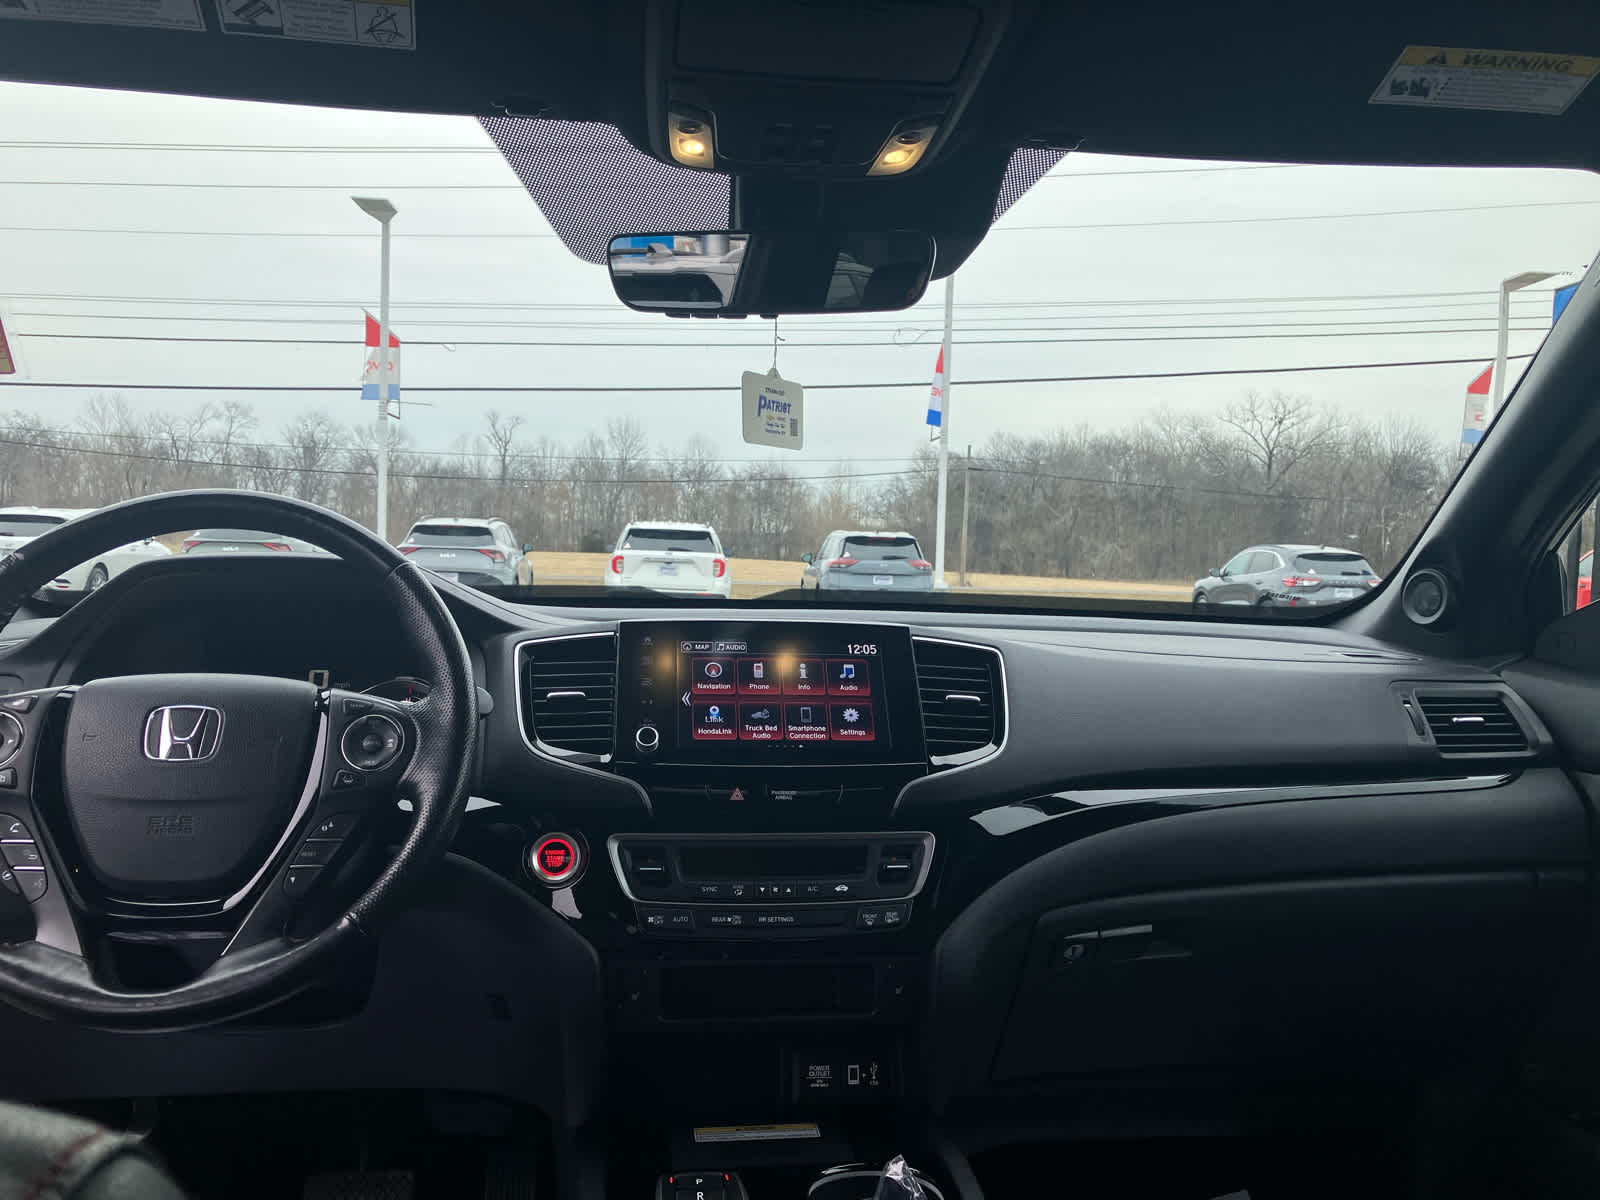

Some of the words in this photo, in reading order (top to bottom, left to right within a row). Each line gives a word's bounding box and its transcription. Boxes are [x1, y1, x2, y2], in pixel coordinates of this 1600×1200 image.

[1462, 54, 1573, 73] WARNING
[757, 394, 792, 416] PATRIOT
[847, 643, 878, 656] 12:05
[697, 682, 731, 691] Navigation
[798, 683, 811, 691] Info
[705, 715, 724, 723] Link
[744, 724, 763, 732] Truck
[764, 724, 778, 732] Bed
[788, 724, 827, 733] Smartphone
[839, 728, 866, 736] Settings
[696, 1191, 704, 1200] R
